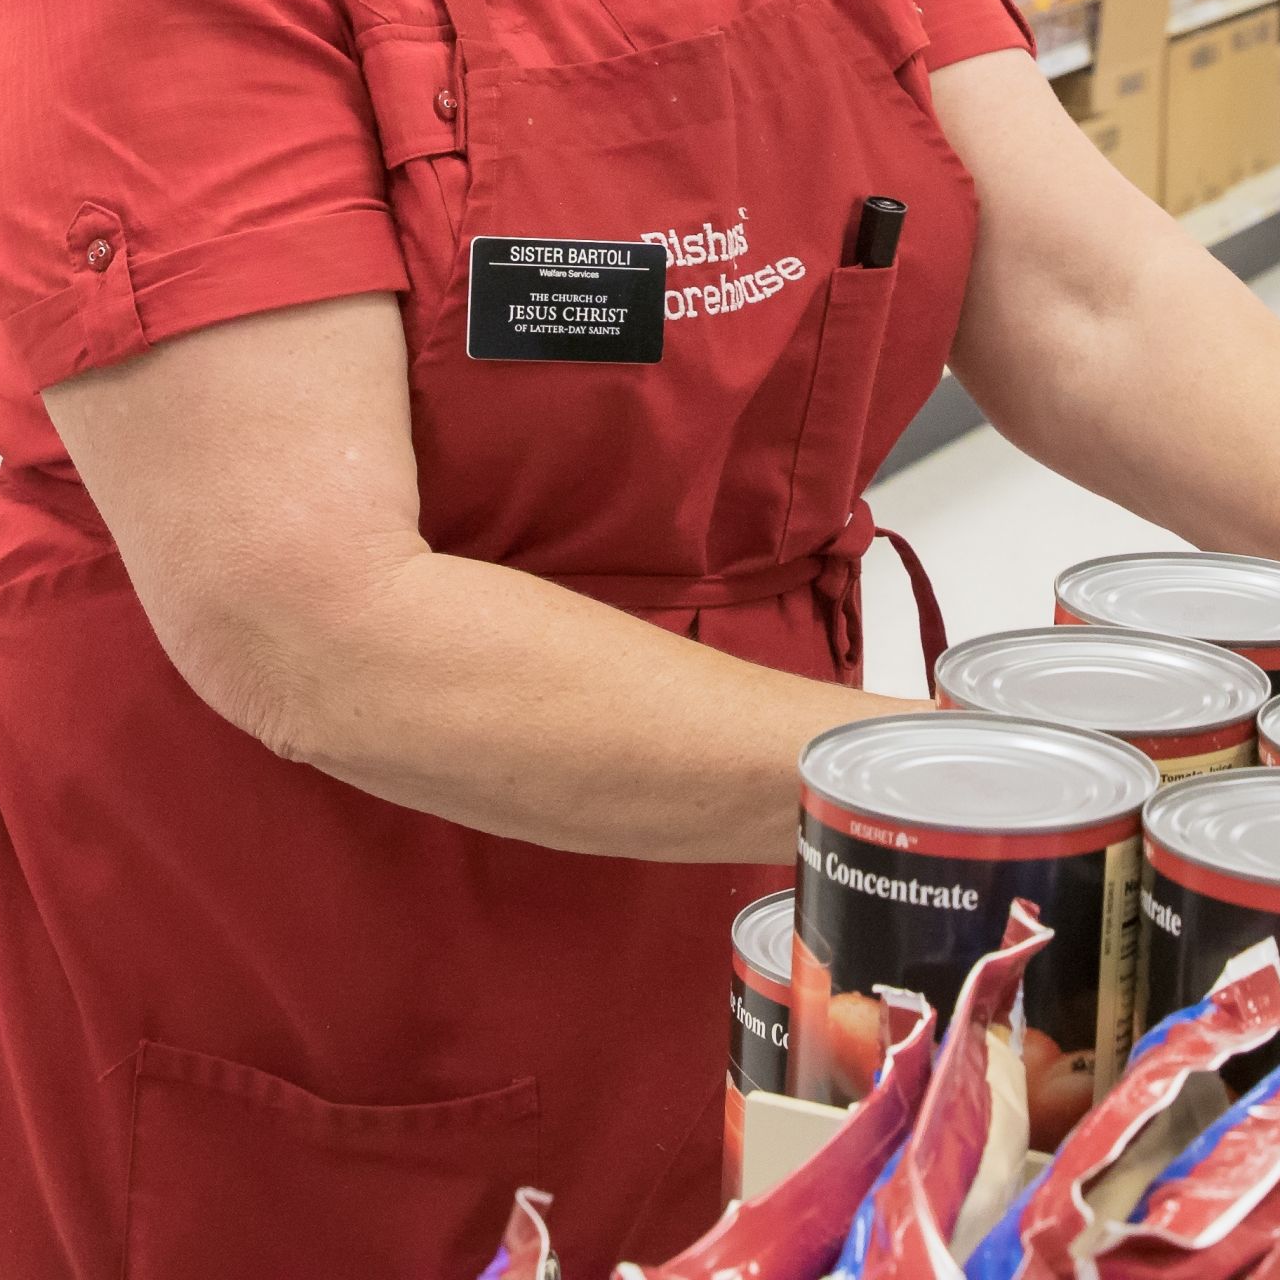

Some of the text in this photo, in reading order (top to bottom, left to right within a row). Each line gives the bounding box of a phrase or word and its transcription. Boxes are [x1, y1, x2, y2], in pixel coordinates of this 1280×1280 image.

[510, 246, 631, 266] SISTER BARTOLI
[539, 268, 600, 279] Welfare Services
[530, 293, 609, 304] THE CHURCH OF
[664, 256, 806, 321] orehouse
[508, 305, 628, 323] JESUS CHRIST
[514, 324, 621, 335] OF LATTER-DAY SAINTS
[849, 821, 895, 846] DESERET
[825, 851, 980, 912] Concentrate
[736, 996, 766, 1039] from
